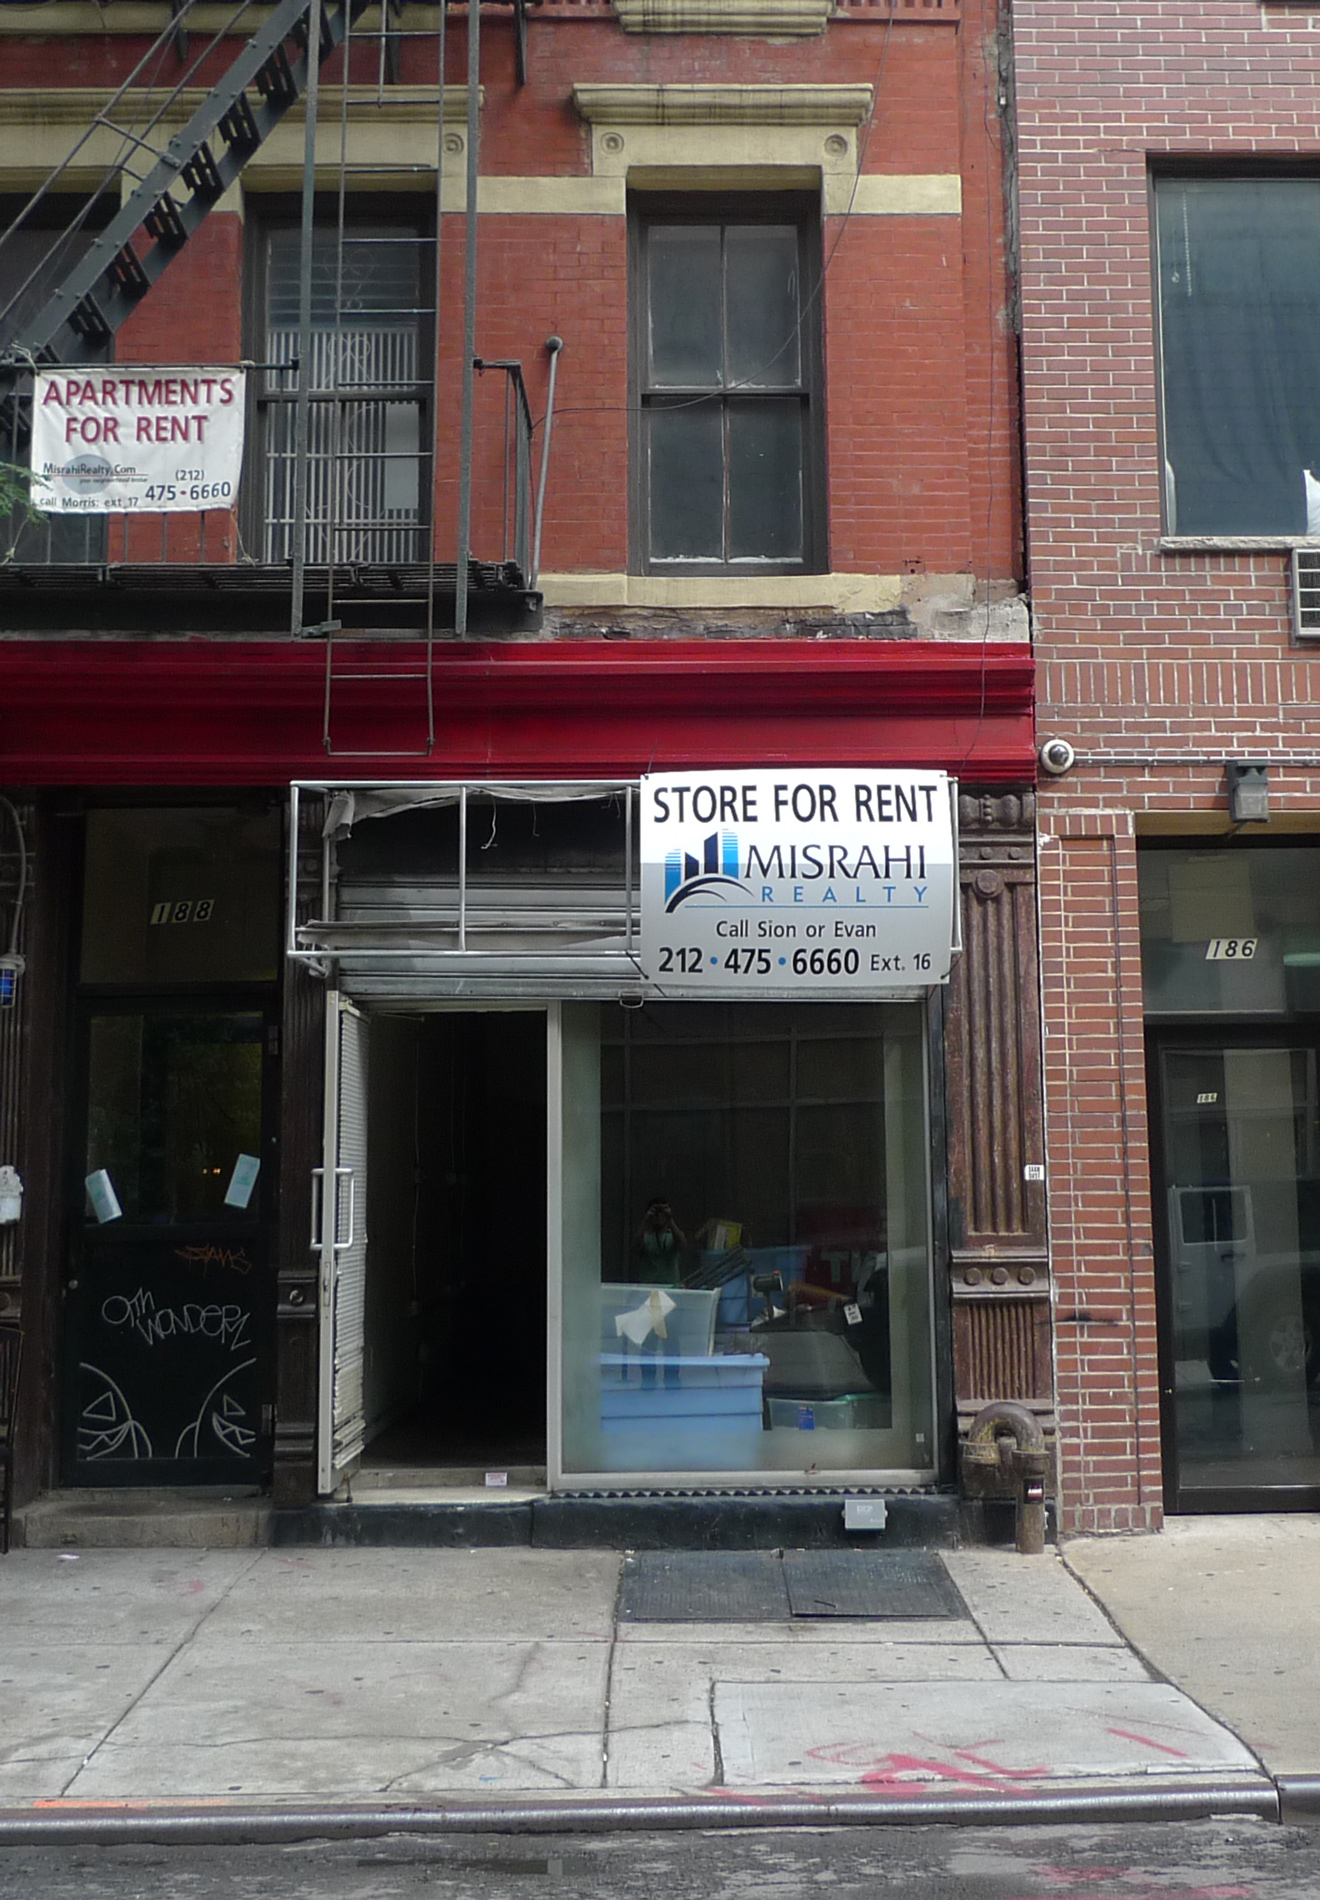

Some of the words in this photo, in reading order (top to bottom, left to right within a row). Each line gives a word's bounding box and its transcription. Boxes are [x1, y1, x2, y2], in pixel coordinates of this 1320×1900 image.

[42, 378, 235, 406] APARTMENTS
[65, 416, 120, 443] FOR
[136, 415, 208, 442] RENT
[175, 469, 205, 482] (212)
[145, 485, 177, 501] 475
[190, 482, 231, 501] 6660
[62, 497, 99, 508] Morris:
[104, 498, 122, 507] ext
[128, 497, 139, 507] 17
[653, 785, 759, 823] STORE
[774, 784, 839, 823] FOR
[855, 784, 938, 823] RENT
[744, 845, 927, 880] MISRAHI
[761, 886, 929, 903] REALTY
[157, 901, 211, 922] 188
[716, 920, 749, 938] Call
[757, 920, 797, 938] Sion
[806, 925, 826, 938] or
[834, 920, 876, 938] Evan
[1212, 940, 1255, 958] 186
[658, 947, 703, 973] 212
[724, 948, 772, 975] 475
[792, 948, 859, 975] 6660
[870, 954, 905, 971] Ext.
[913, 953, 931, 971] 16
[1198, 1093, 1217, 1103] 186
